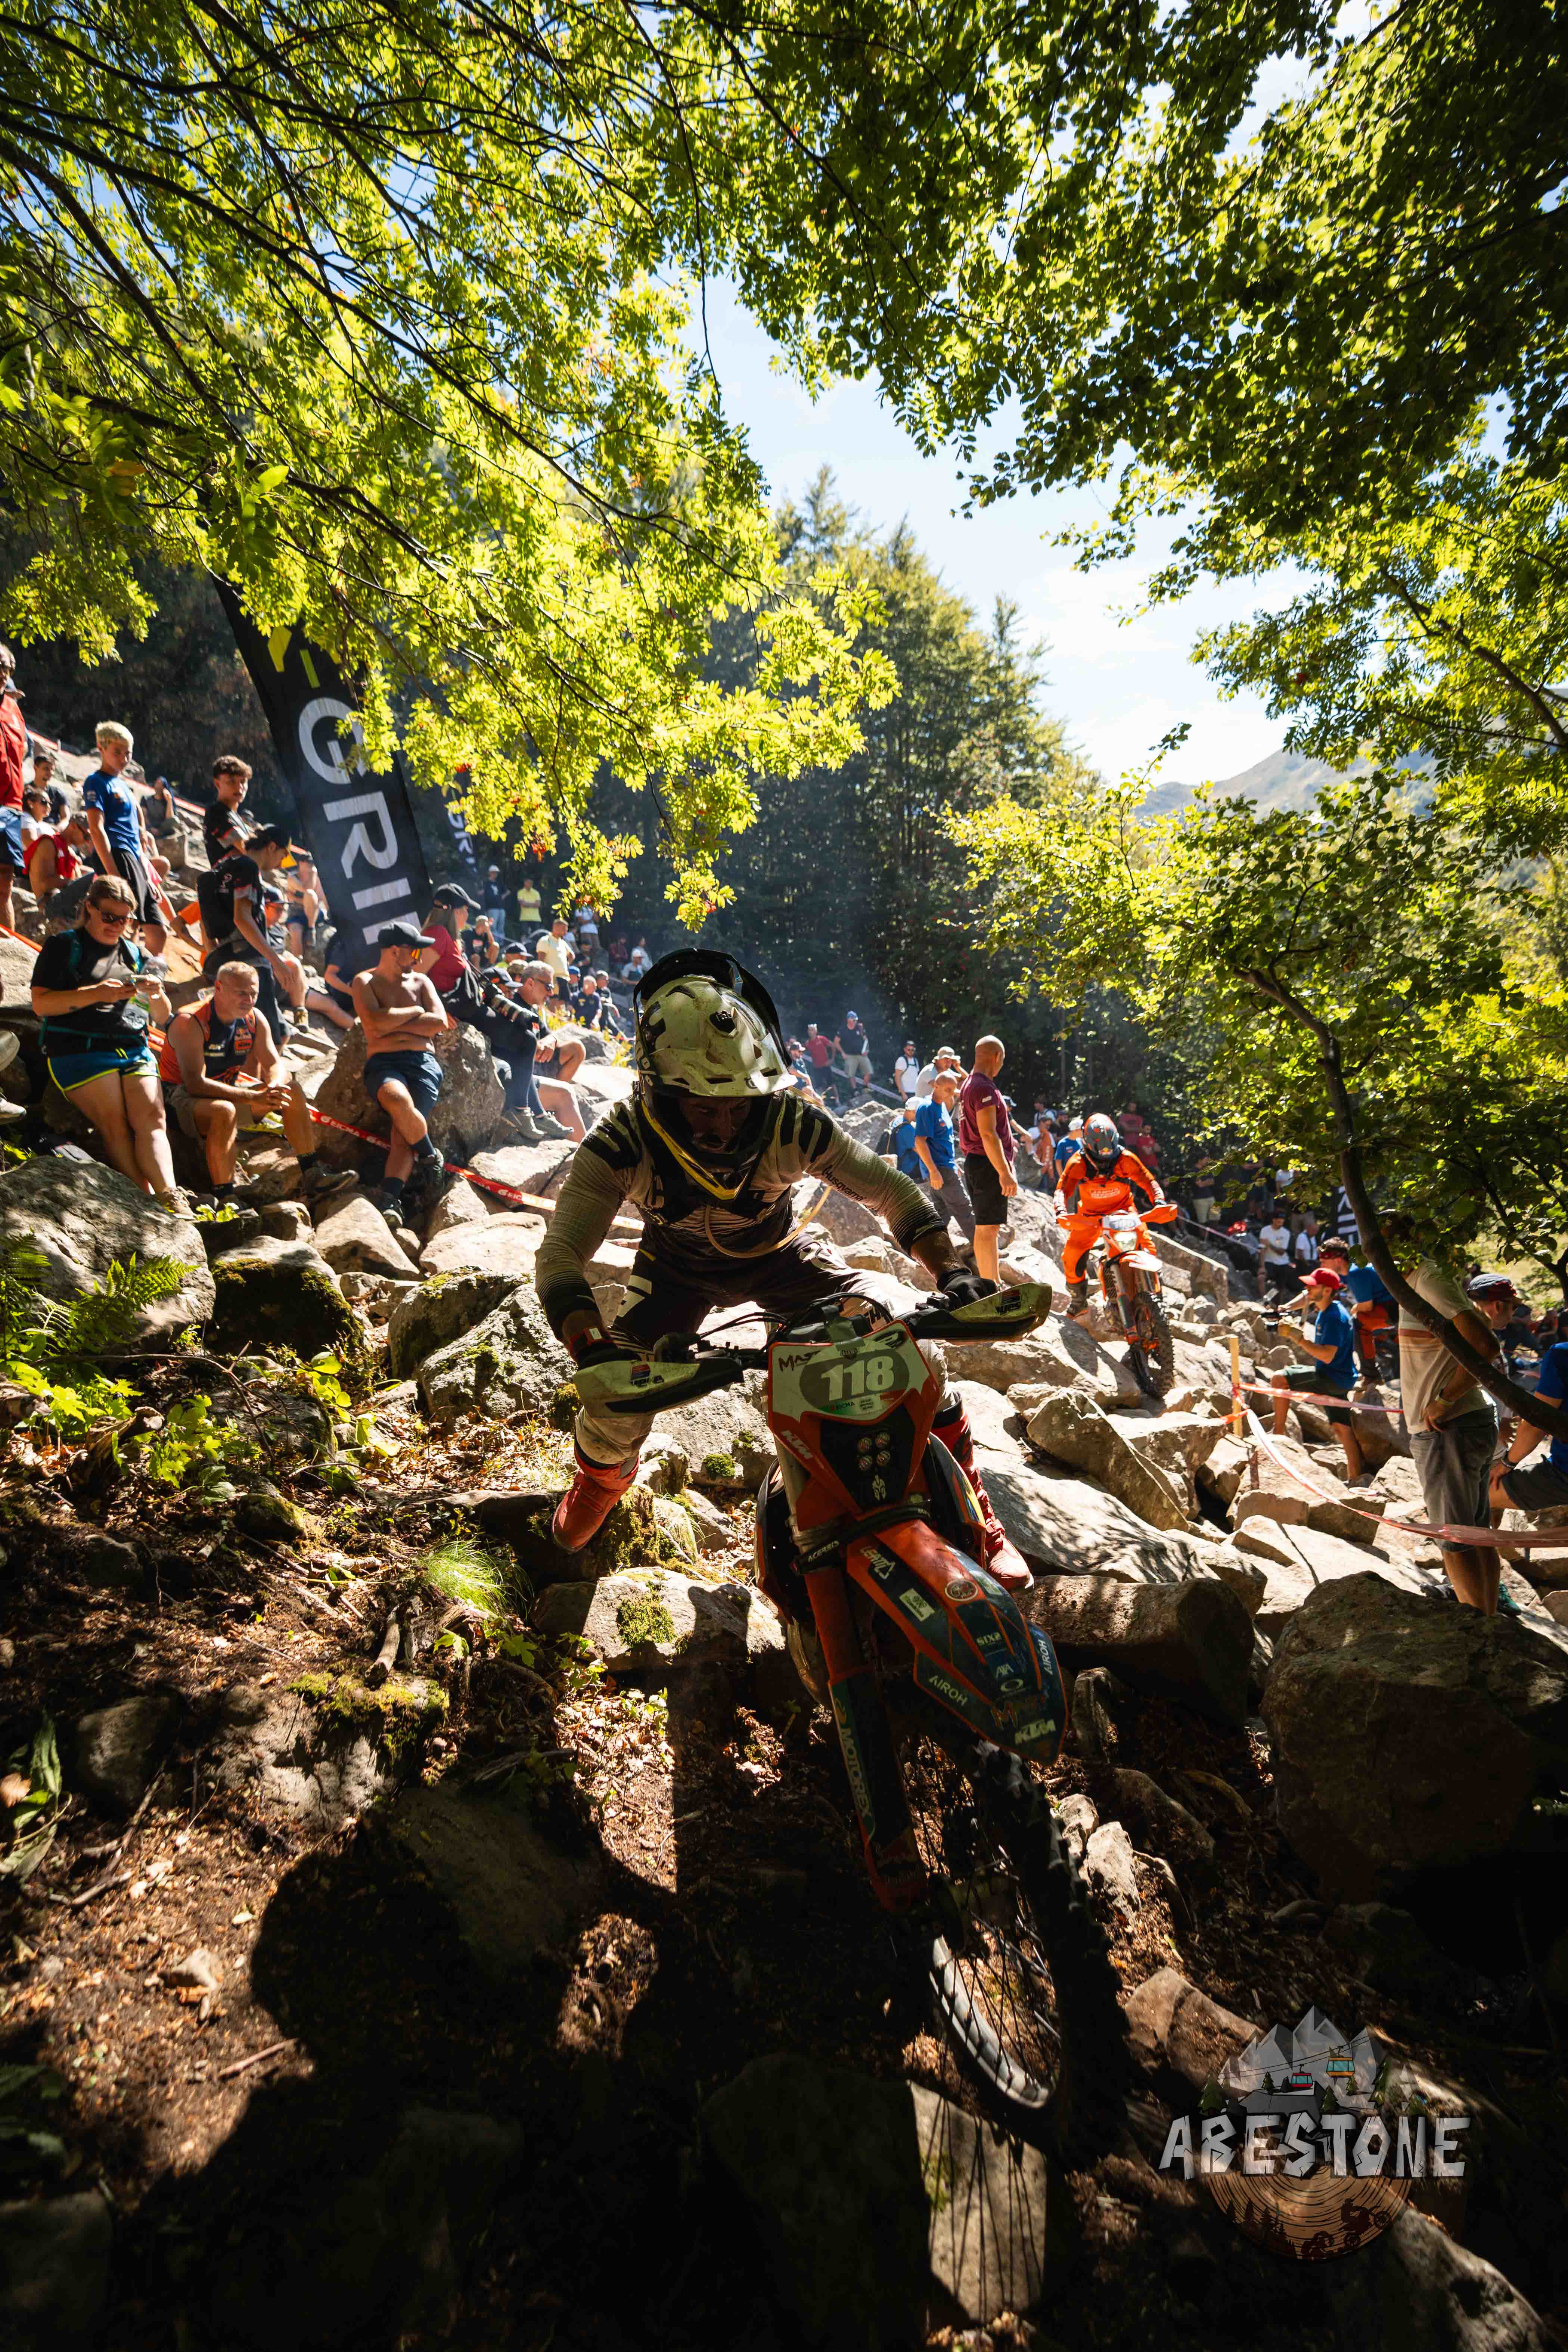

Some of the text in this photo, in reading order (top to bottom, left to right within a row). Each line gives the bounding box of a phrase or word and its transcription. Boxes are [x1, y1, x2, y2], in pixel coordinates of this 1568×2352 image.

[822, 1165, 867, 1201] Husqvarna
[820, 1355, 895, 1401] 118
[780, 1430, 813, 1459] KTM
[807, 1540, 840, 1563] ACERBIS
[1038, 1638, 1054, 1676] AIROH
[929, 1675, 968, 1706] AIROH
[1014, 1718, 1057, 1744] KTM
[839, 1726, 873, 1817] MOTOREX
